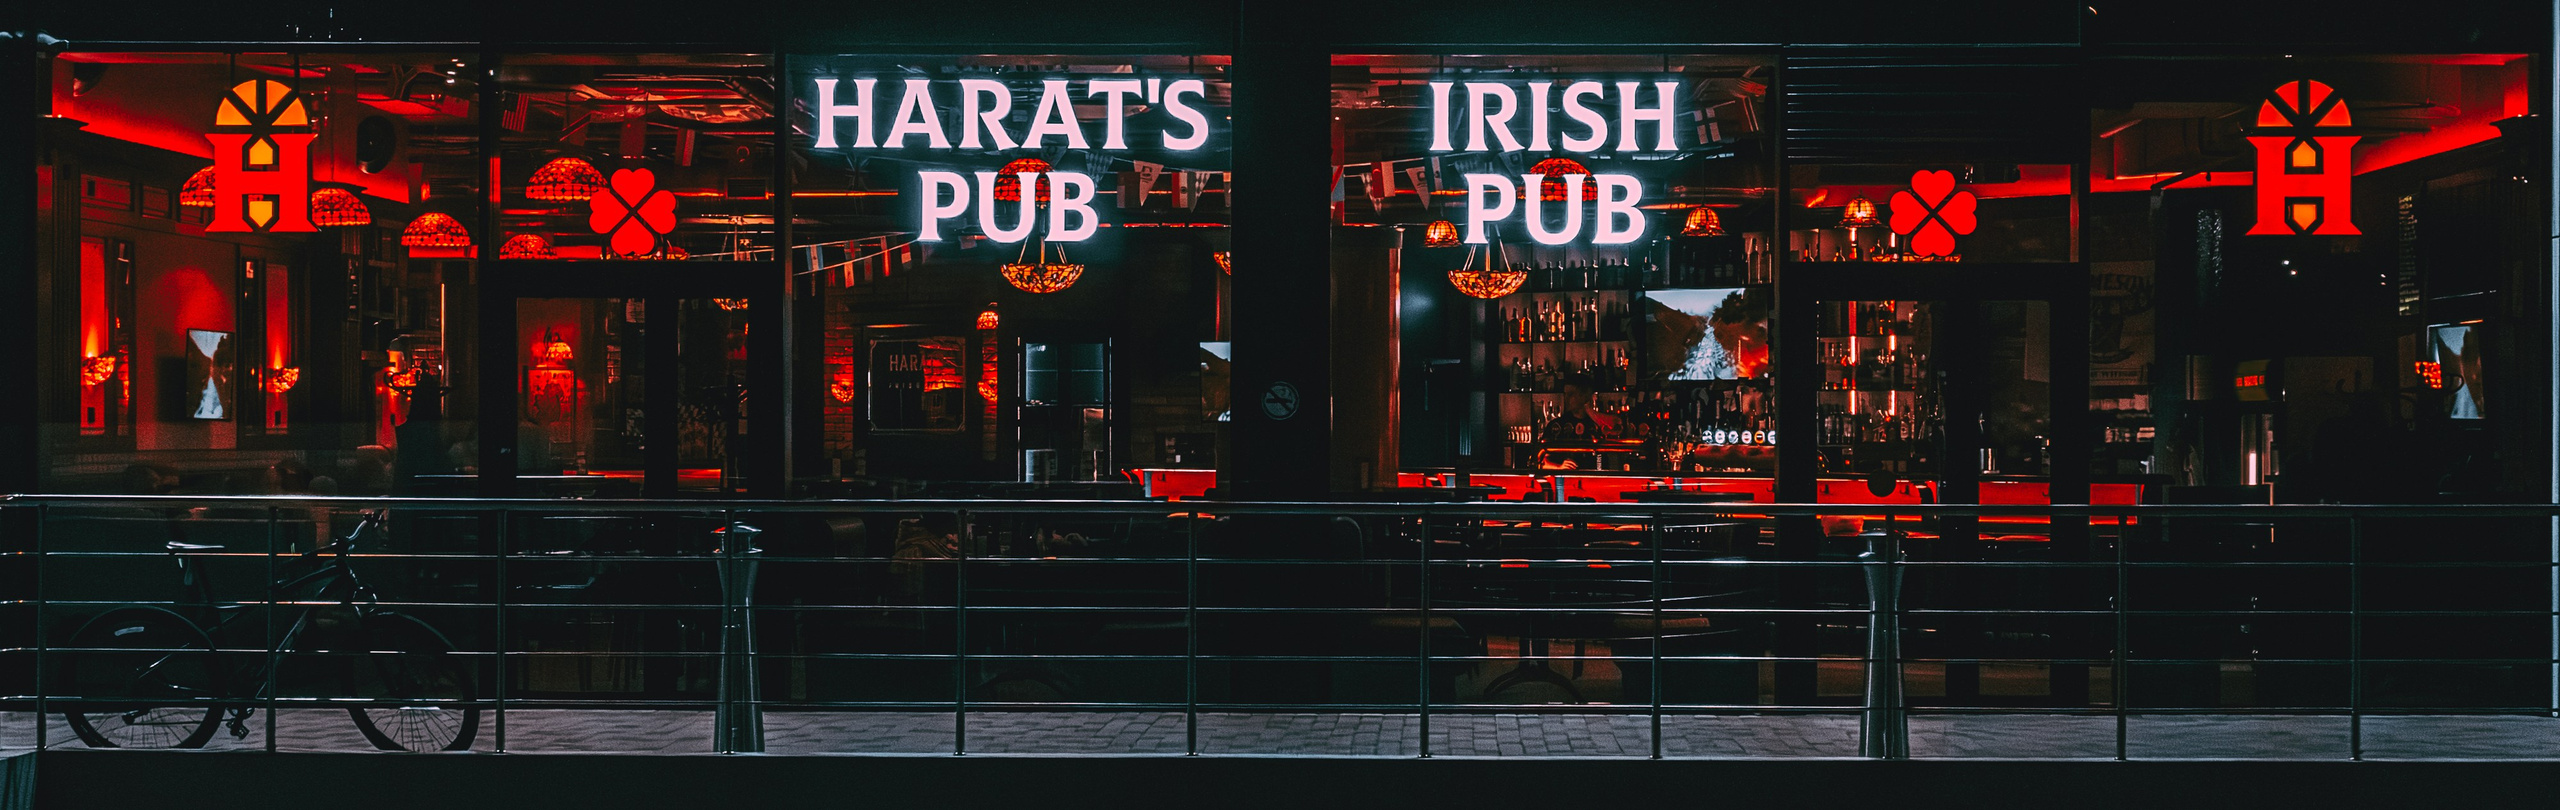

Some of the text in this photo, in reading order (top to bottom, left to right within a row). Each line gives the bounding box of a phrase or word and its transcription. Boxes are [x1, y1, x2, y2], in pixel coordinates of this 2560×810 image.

[815, 78, 1209, 150] HARAT'S
[1430, 81, 1680, 152] IRISH
[918, 171, 1099, 243] PUB
[1465, 174, 1646, 245] PUB
